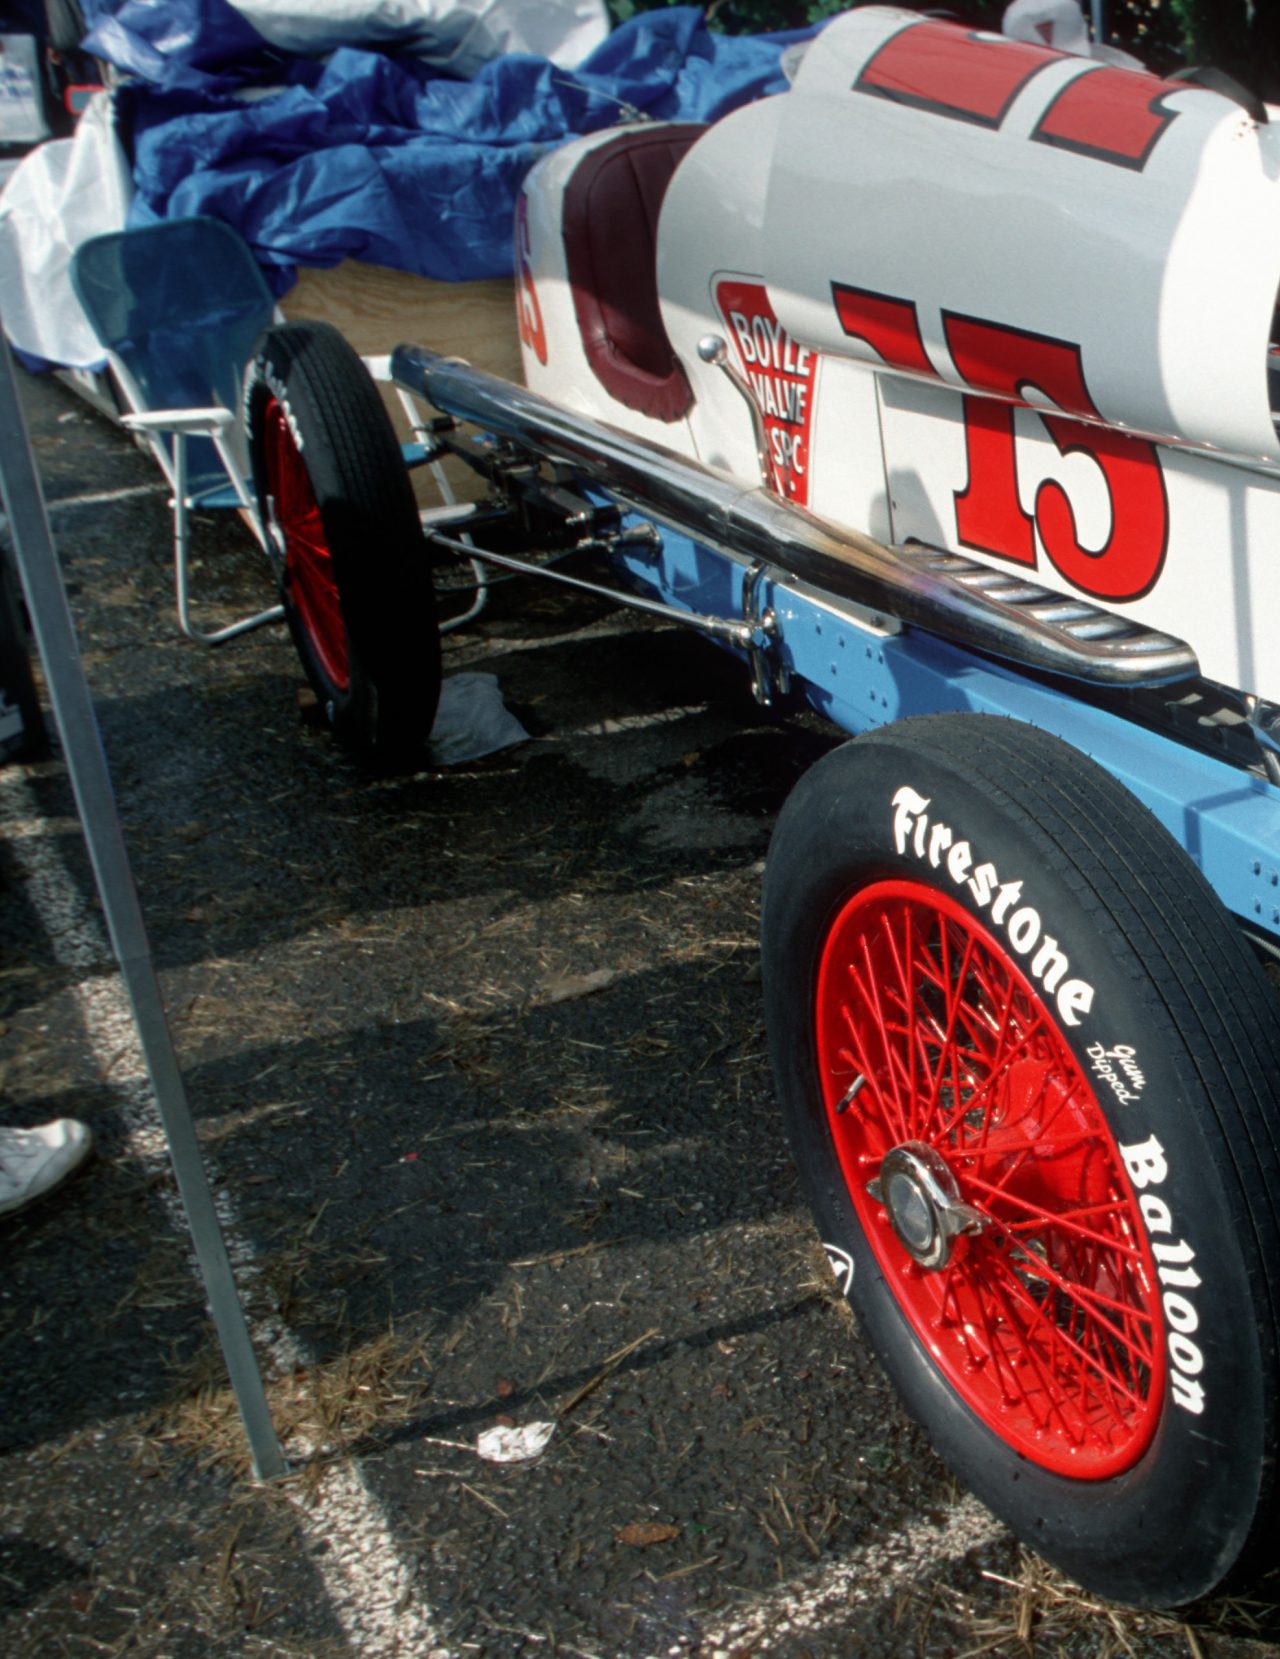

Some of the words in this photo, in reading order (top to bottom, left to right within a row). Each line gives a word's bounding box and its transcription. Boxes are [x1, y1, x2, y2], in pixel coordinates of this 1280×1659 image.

[729, 311, 811, 377] BOYLE
[750, 370, 807, 424] VALVE
[830, 281, 1170, 604] 15
[891, 785, 1096, 1028] Firestone
[1086, 1041, 1140, 1106] Dipped
[1118, 1132, 1206, 1414] Balloon
